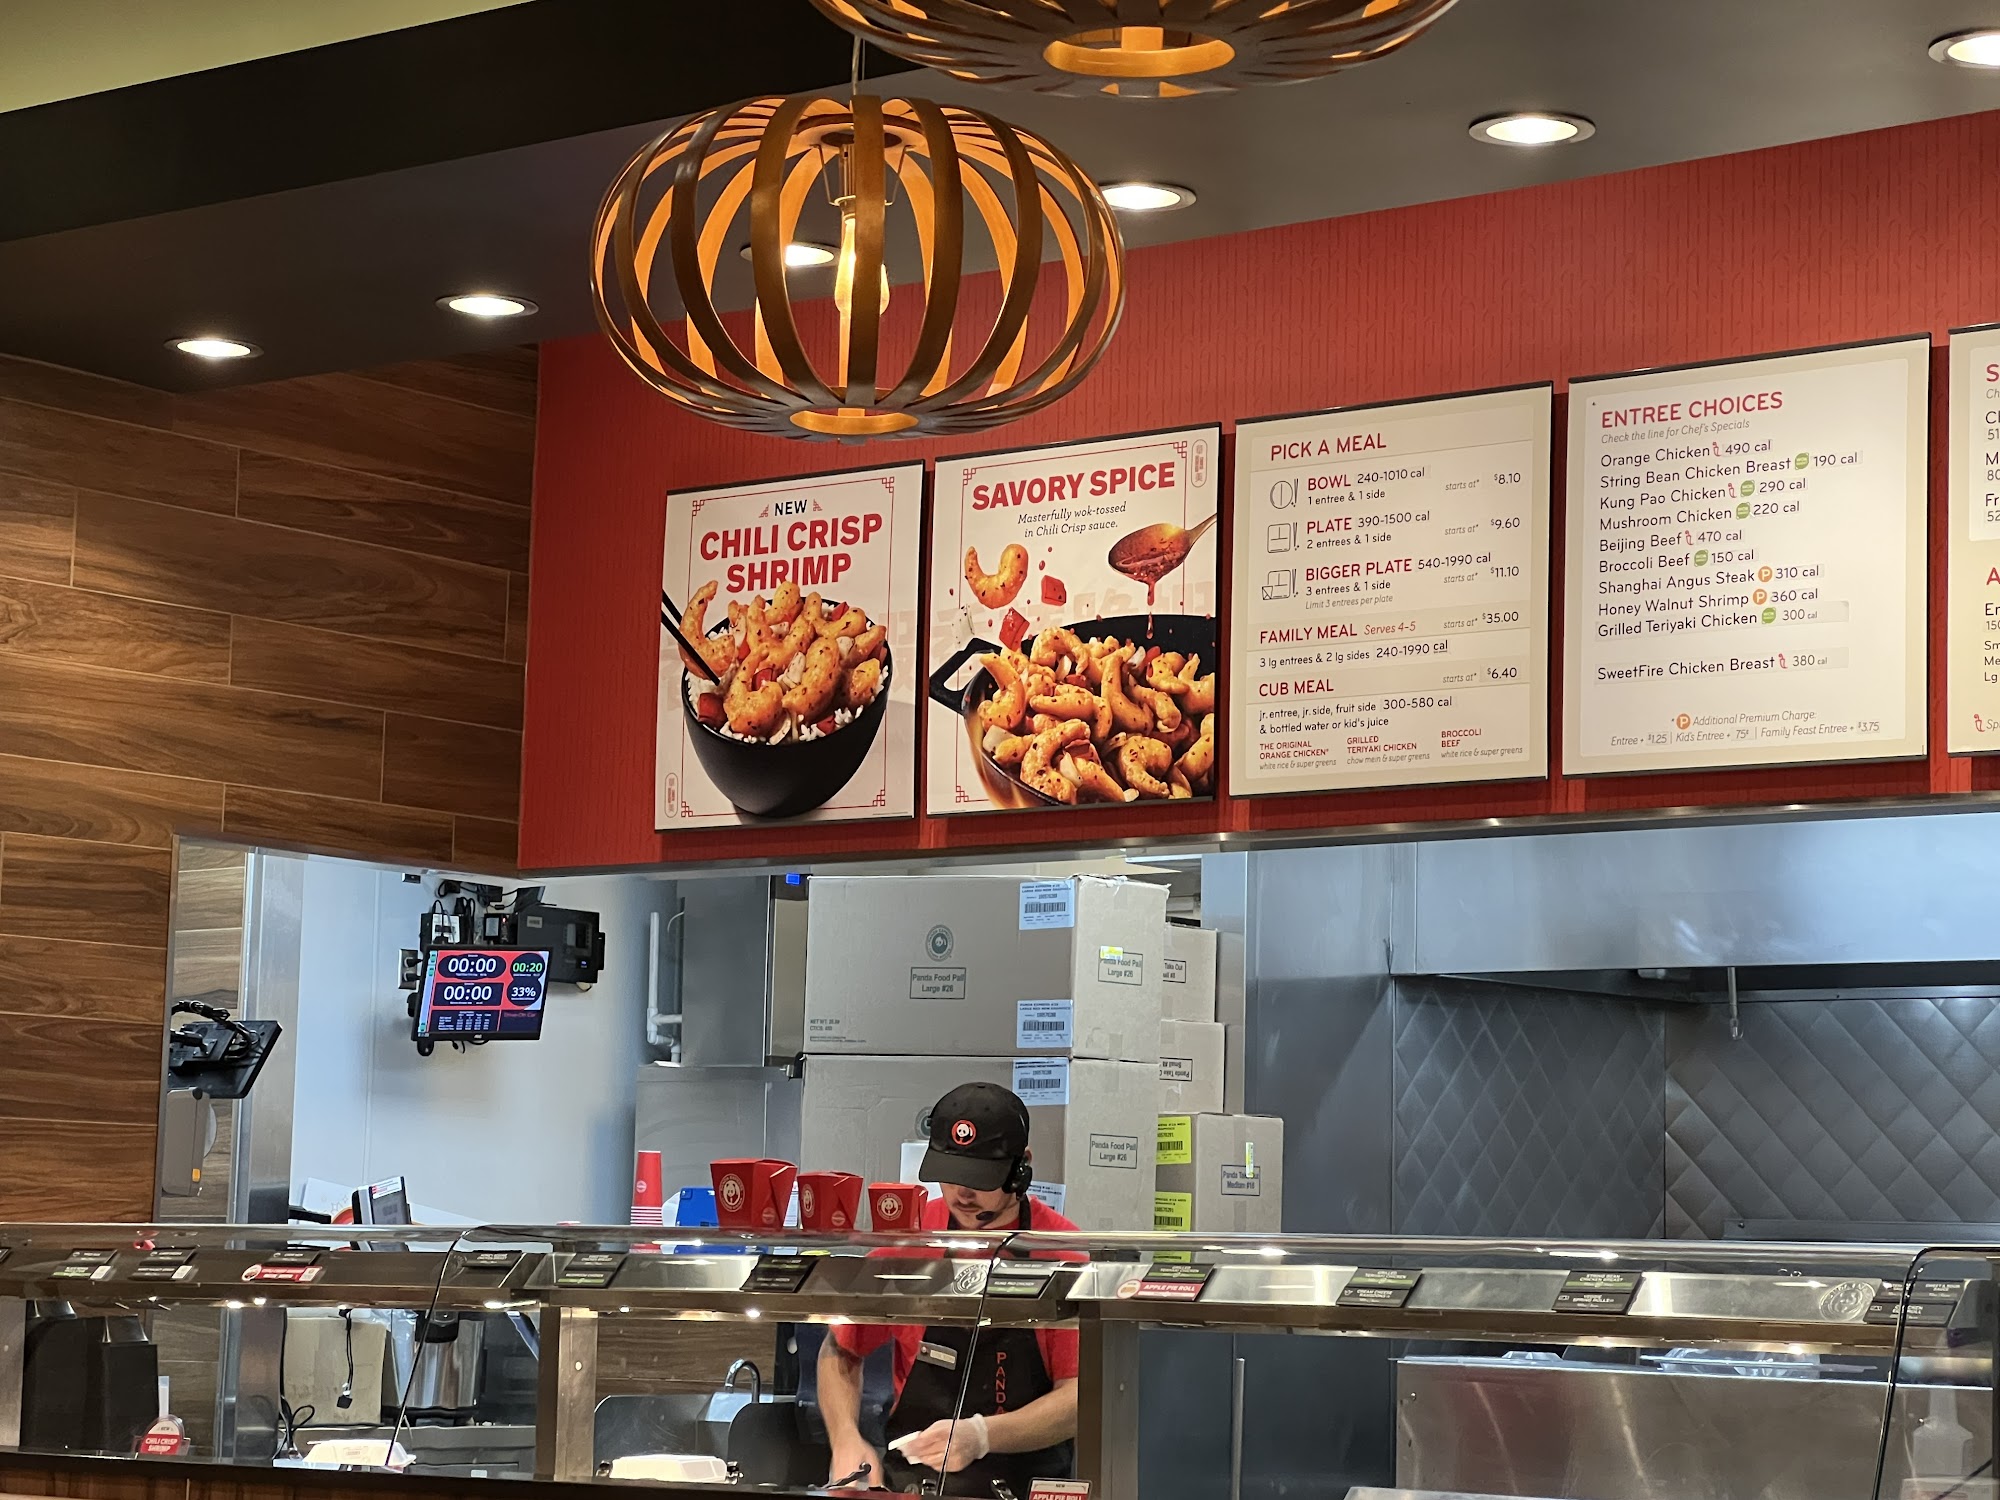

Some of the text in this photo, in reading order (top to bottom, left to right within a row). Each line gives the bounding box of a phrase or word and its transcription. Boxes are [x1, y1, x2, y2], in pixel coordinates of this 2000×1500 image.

[1602, 391, 1782, 428] ENTREE CHOICES
[1602, 419, 1750, 444] Check the line for Chef's Specials
[1271, 433, 1386, 461] PICK A MEAL
[1601, 440, 1770, 467] Orange Chicken 490 cal
[1308, 467, 1424, 491] BOWL 240-1010 cal
[1494, 472, 1520, 485] $8.10
[1600, 452, 1857, 488] String Bean Chicken Breast 190 cal
[972, 473, 1085, 510] SAVORY
[1089, 462, 1175, 496] SPICE
[1445, 482, 1466, 491] starts
[1600, 478, 1805, 510] Kung Pao Chicken 290 cal
[1308, 489, 1385, 505] 1 entree & 1 side
[774, 499, 808, 517] NEW
[1018, 501, 1126, 524] Masterfully wok-tossed
[1600, 501, 1799, 530] Mushroom Chicken 220 cal
[1024, 520, 1118, 538] in Chili Crisp sauce.
[1307, 510, 1430, 534] PLATE 390-1500 cal
[1491, 517, 1520, 530] $9.60
[700, 513, 883, 561] CHILI CRISP
[1600, 530, 1742, 553] Beijing Beef 470 cal
[1306, 552, 1490, 581] BIGGER PLATE 540-1990 cal
[1600, 549, 1754, 572] Broccoli Beef 150 cal
[726, 552, 852, 593] SHRIMP
[1491, 566, 1519, 577] $11.10
[1599, 565, 1818, 594] Shanghai Angus Steak 310 cal
[1599, 588, 1818, 616] Honey Walnut Shrimp 360 cal
[1483, 612, 1518, 624] $35.00
[1598, 609, 1817, 636] Grilled Teriyaki Chicken 300 cal
[1260, 621, 1416, 644] FAMILY MEAL Serves 4-5
[1376, 640, 1448, 658] 240-1990 cal
[1488, 668, 1517, 679] $6.40
[1598, 664, 1663, 680] SweetFire
[1669, 661, 1724, 675] Chicken
[1730, 657, 1774, 670] Breast
[1793, 654, 1815, 666] 380
[1985, 672, 1997, 683] Lg
[1259, 679, 1334, 696] CUB MEAL
[1259, 696, 1452, 721] jr. entree, jr. side, fruit side 300-580 cal
[1260, 725, 1266, 734] &
[1270, 722, 1302, 733] bottled
[1305, 722, 1329, 730] water
[1344, 718, 1364, 728] kid's
[1367, 719, 1388, 729] juice
[1692, 714, 1738, 726] Additional
[1739, 713, 1780, 722] Premium
[1347, 736, 1378, 744] GRILLED
[1442, 728, 1481, 738] BROCCOLI
[1276, 741, 1312, 750] ORIGINAL
[1347, 743, 1416, 754] TERIYAKI CHICKEN
[1442, 740, 1460, 748] BEEF
[1260, 751, 1291, 760] ORANGE
[448, 958, 496, 972] 00:00
[513, 963, 542, 972] 00:20
[444, 986, 492, 1000] 00:00
[511, 987, 536, 996] 33%
[922, 984, 940, 993] Large
[1100, 1152, 1116, 1162] Large
[995, 1352, 1006, 1414] PANDA
